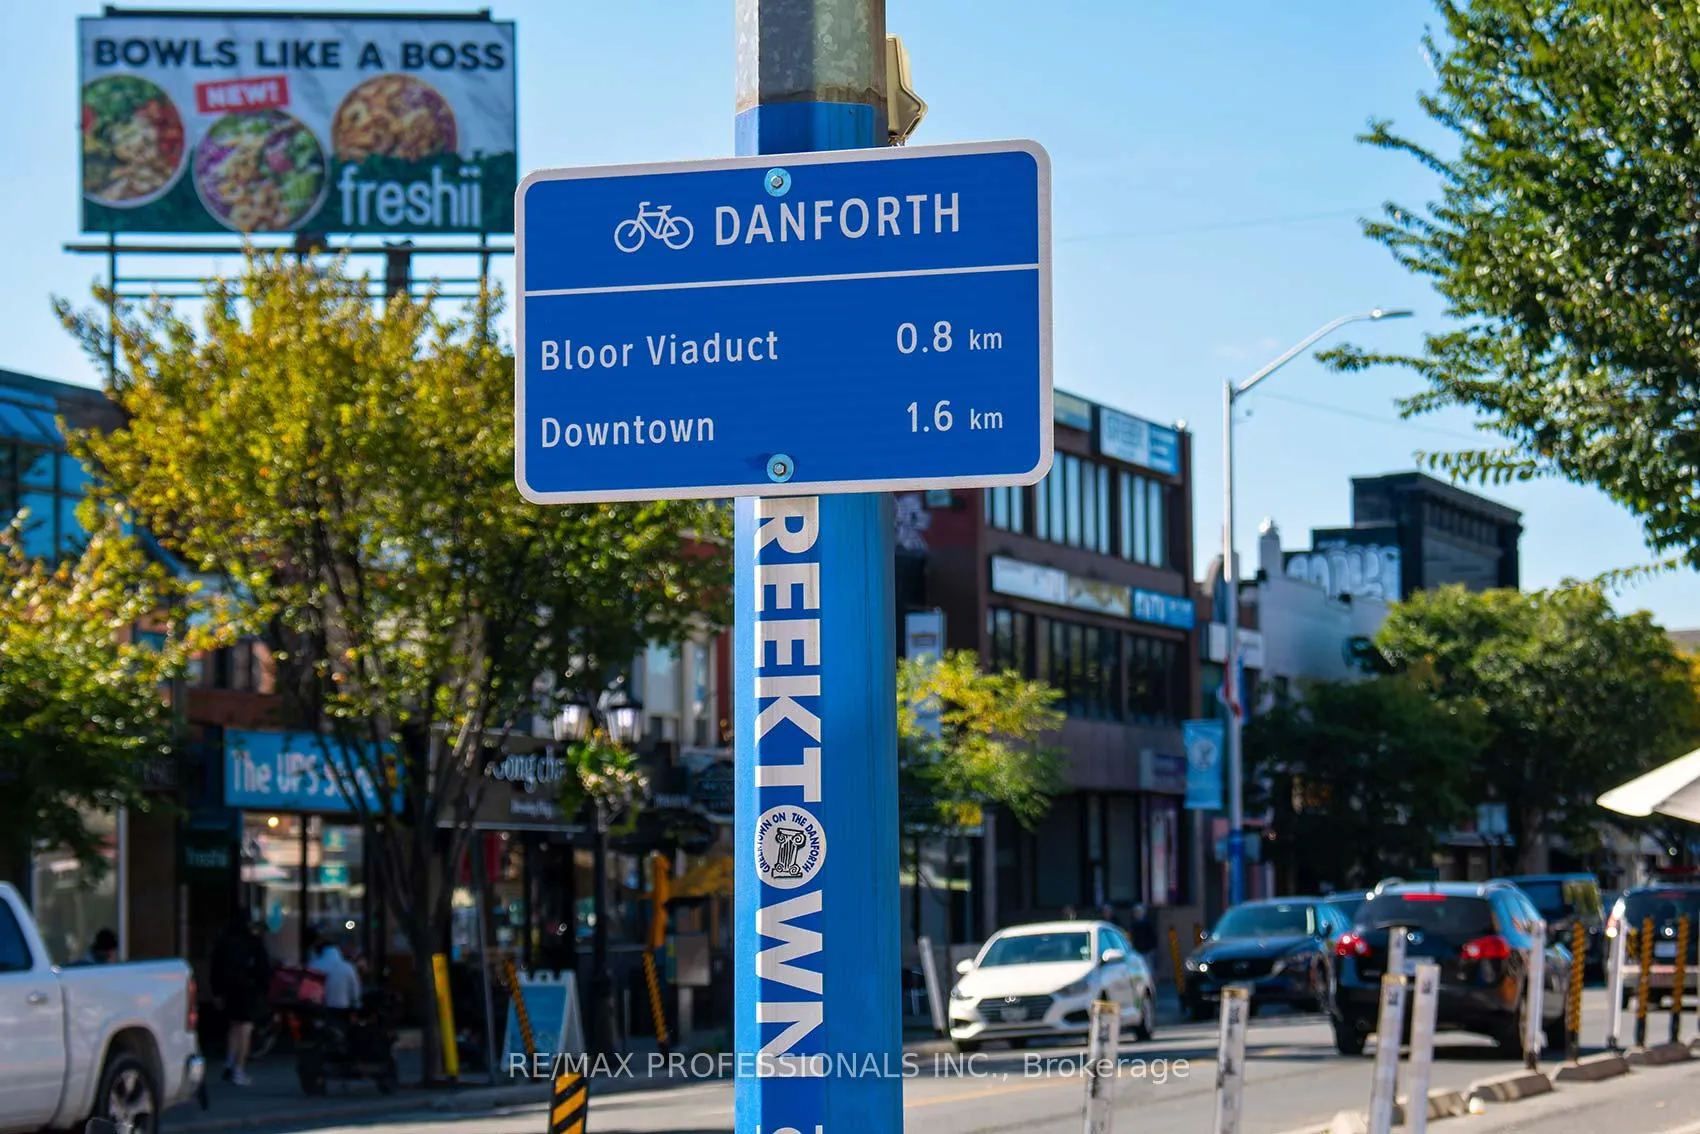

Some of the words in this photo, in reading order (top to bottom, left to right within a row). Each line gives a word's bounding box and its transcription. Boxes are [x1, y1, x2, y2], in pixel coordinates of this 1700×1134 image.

[94, 38, 237, 68] BOWLS
[256, 39, 341, 69] LIKE
[357, 41, 384, 70] A
[401, 42, 505, 71] BOSS
[205, 79, 280, 109] NEW!
[337, 164, 483, 228] freshii
[715, 192, 960, 247] DANFORTH
[541, 339, 634, 371] Bloor
[646, 331, 779, 366] Viaduct
[896, 320, 953, 354] 0.8
[969, 329, 1003, 351] km
[541, 415, 715, 448] Downtown
[906, 400, 953, 433] 1.6
[969, 408, 1004, 431] km
[233, 749, 272, 794] The
[277, 753, 319, 796] UPS
[772, 812, 787, 823] ON
[791, 812, 808, 827] THE
[802, 823, 820, 873] DANFORTH
